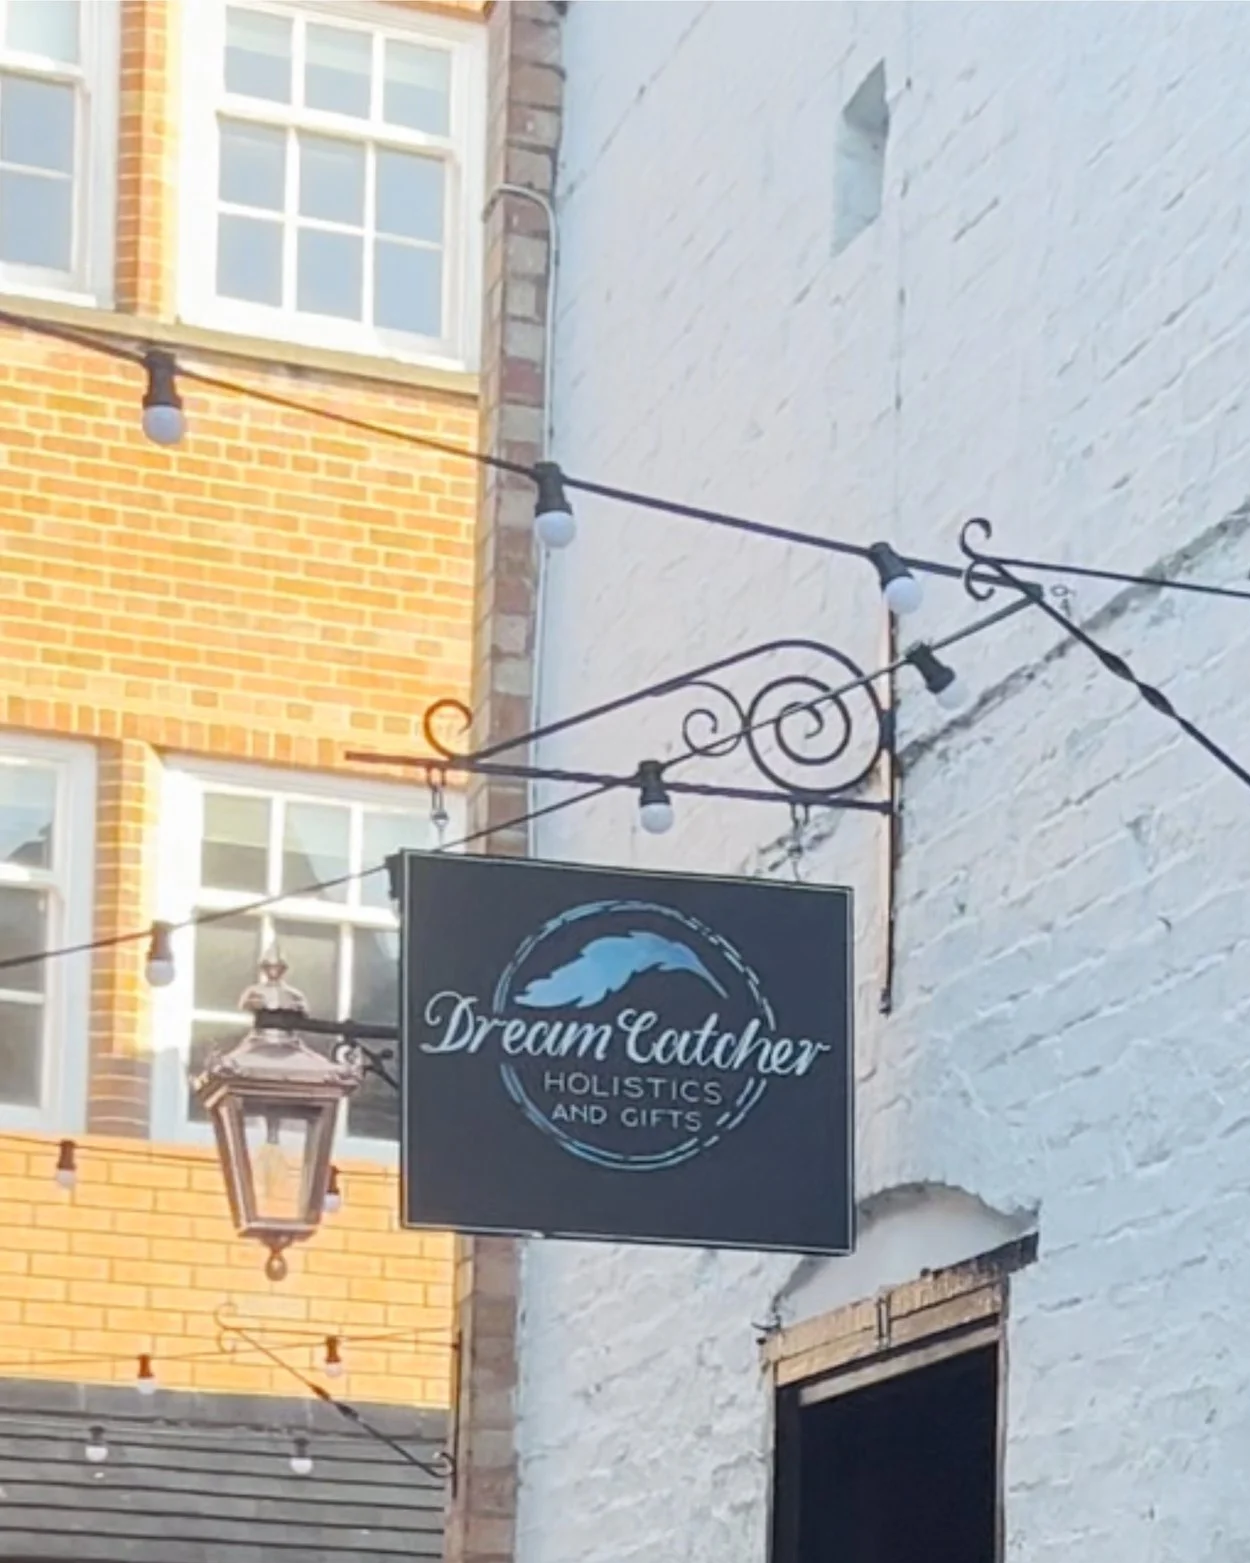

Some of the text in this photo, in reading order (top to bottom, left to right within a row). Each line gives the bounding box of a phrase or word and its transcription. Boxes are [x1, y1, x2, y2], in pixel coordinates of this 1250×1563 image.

[420, 990, 831, 1077] Dream Catcher
[544, 1071, 723, 1105] HOLISTICS
[550, 1103, 703, 1132] AND GIFTS
